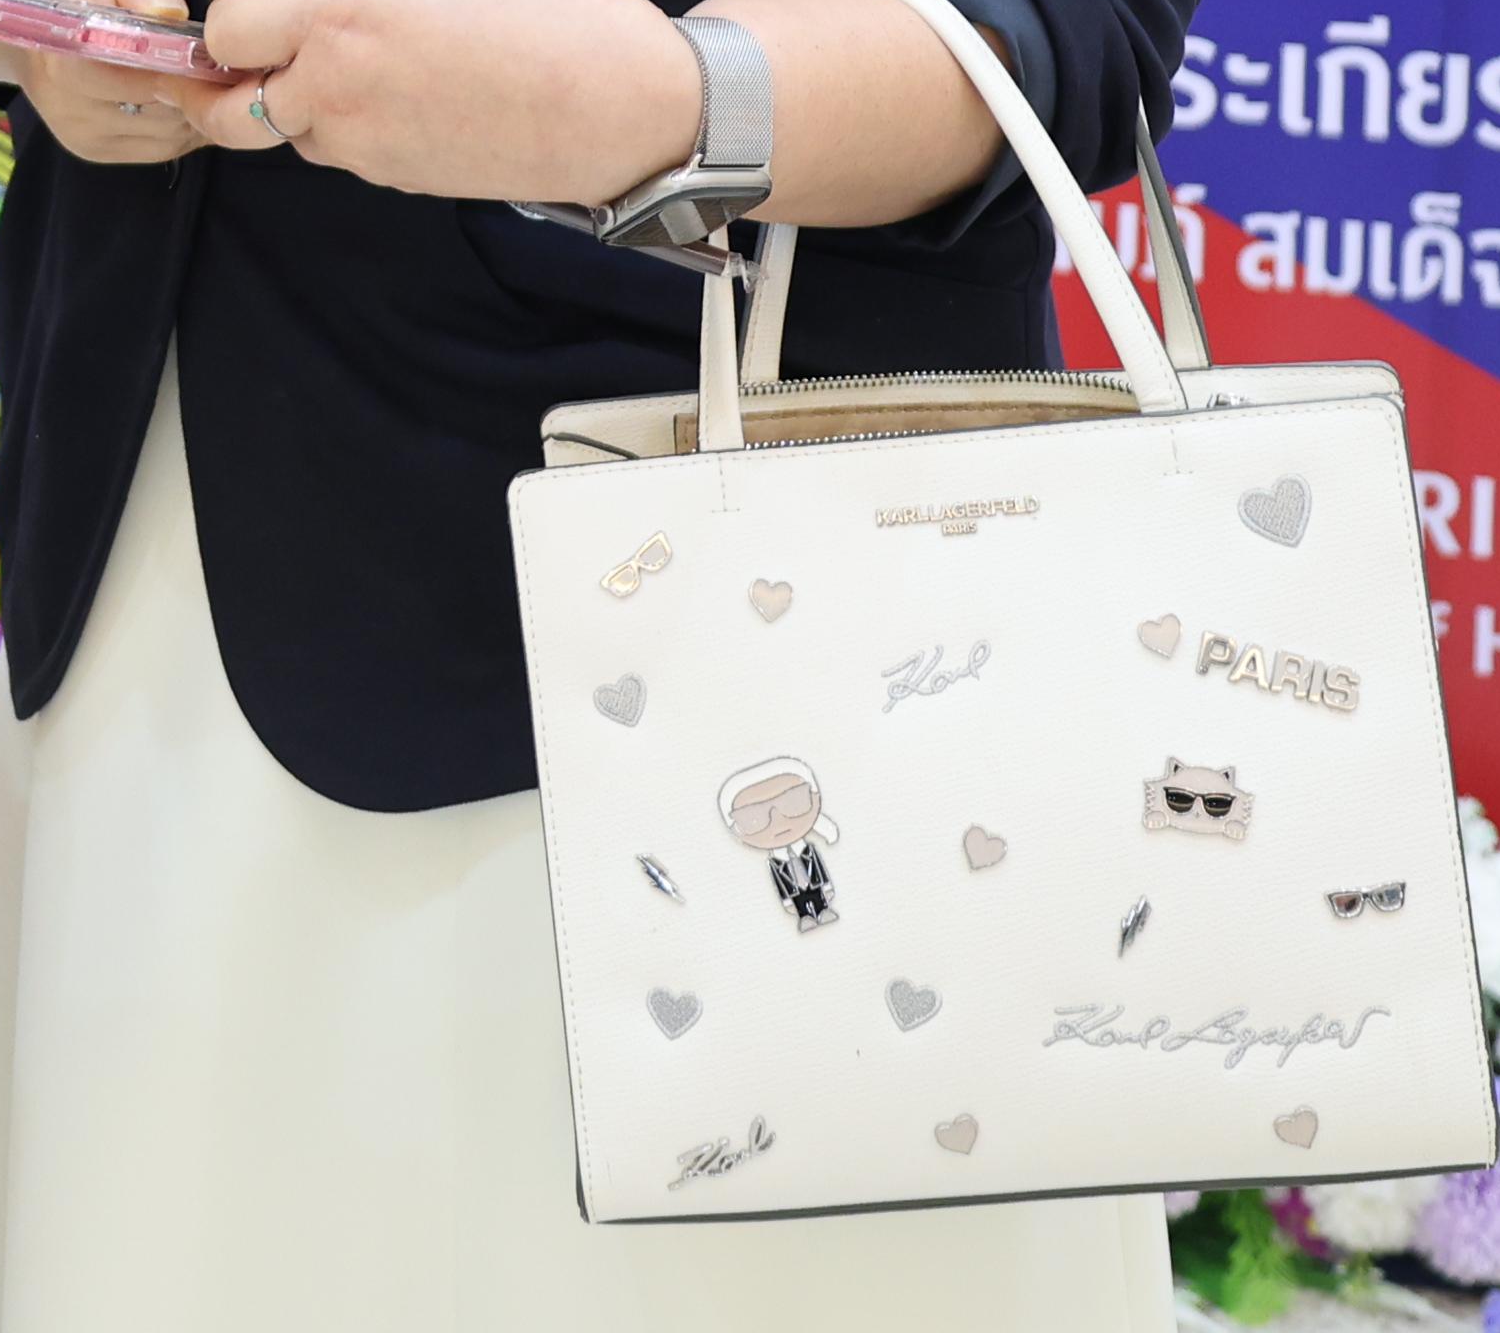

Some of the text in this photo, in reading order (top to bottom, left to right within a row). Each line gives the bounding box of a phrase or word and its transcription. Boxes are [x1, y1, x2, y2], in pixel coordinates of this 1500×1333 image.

[941, 522, 978, 536] PARIS
[880, 638, 992, 715] Karl
[1196, 629, 1362, 713] PARIS
[667, 1114, 777, 1193] Karl
